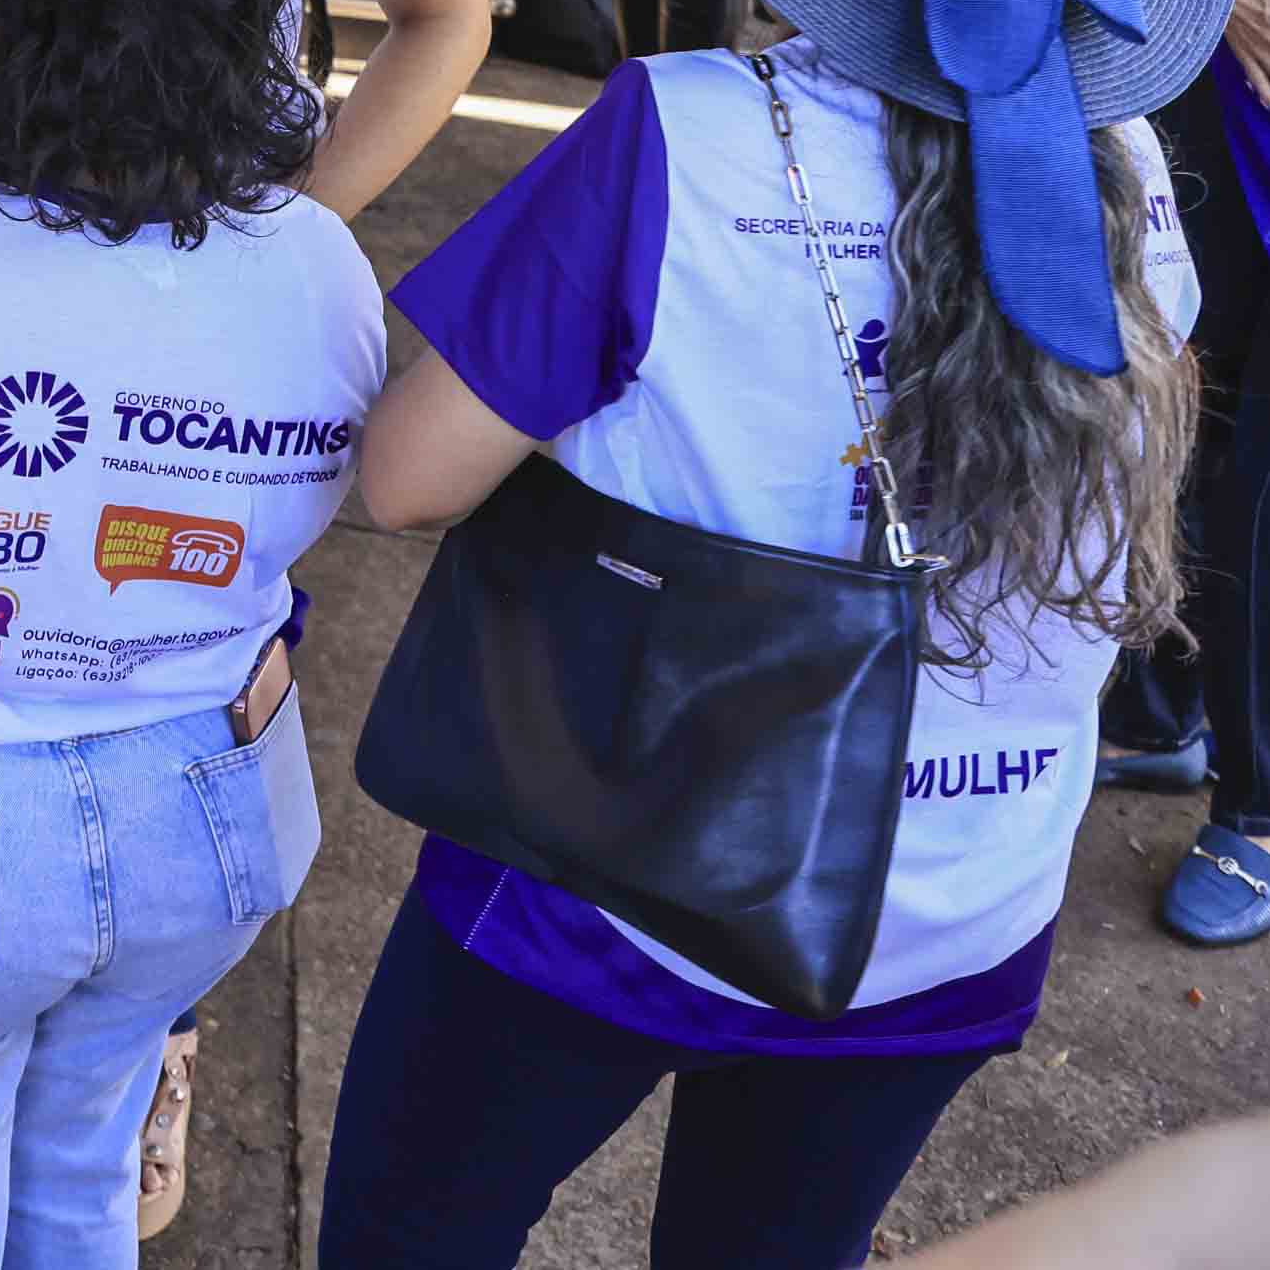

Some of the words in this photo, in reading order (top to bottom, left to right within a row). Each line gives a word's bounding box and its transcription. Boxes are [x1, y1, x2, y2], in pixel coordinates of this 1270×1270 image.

[735, 217, 854, 236] SECRERIA
[860, 222, 885, 237] DA
[115, 391, 197, 413] GOVERNO
[200, 401, 225, 416] DO
[113, 405, 349, 457] TOCANTINS
[100, 457, 209, 482] TRABALHANDO
[212, 470, 222, 483] E
[225, 470, 289, 486] CUIDANDO
[291, 472, 304, 485] DE
[107, 520, 171, 543] DISQUE
[103, 538, 165, 557] DIREITOS
[101, 553, 161, 569] HUMANOS
[169, 546, 229, 577] 100
[21, 648, 105, 668] WhatsApp:
[16, 665, 78, 681] Ligação:
